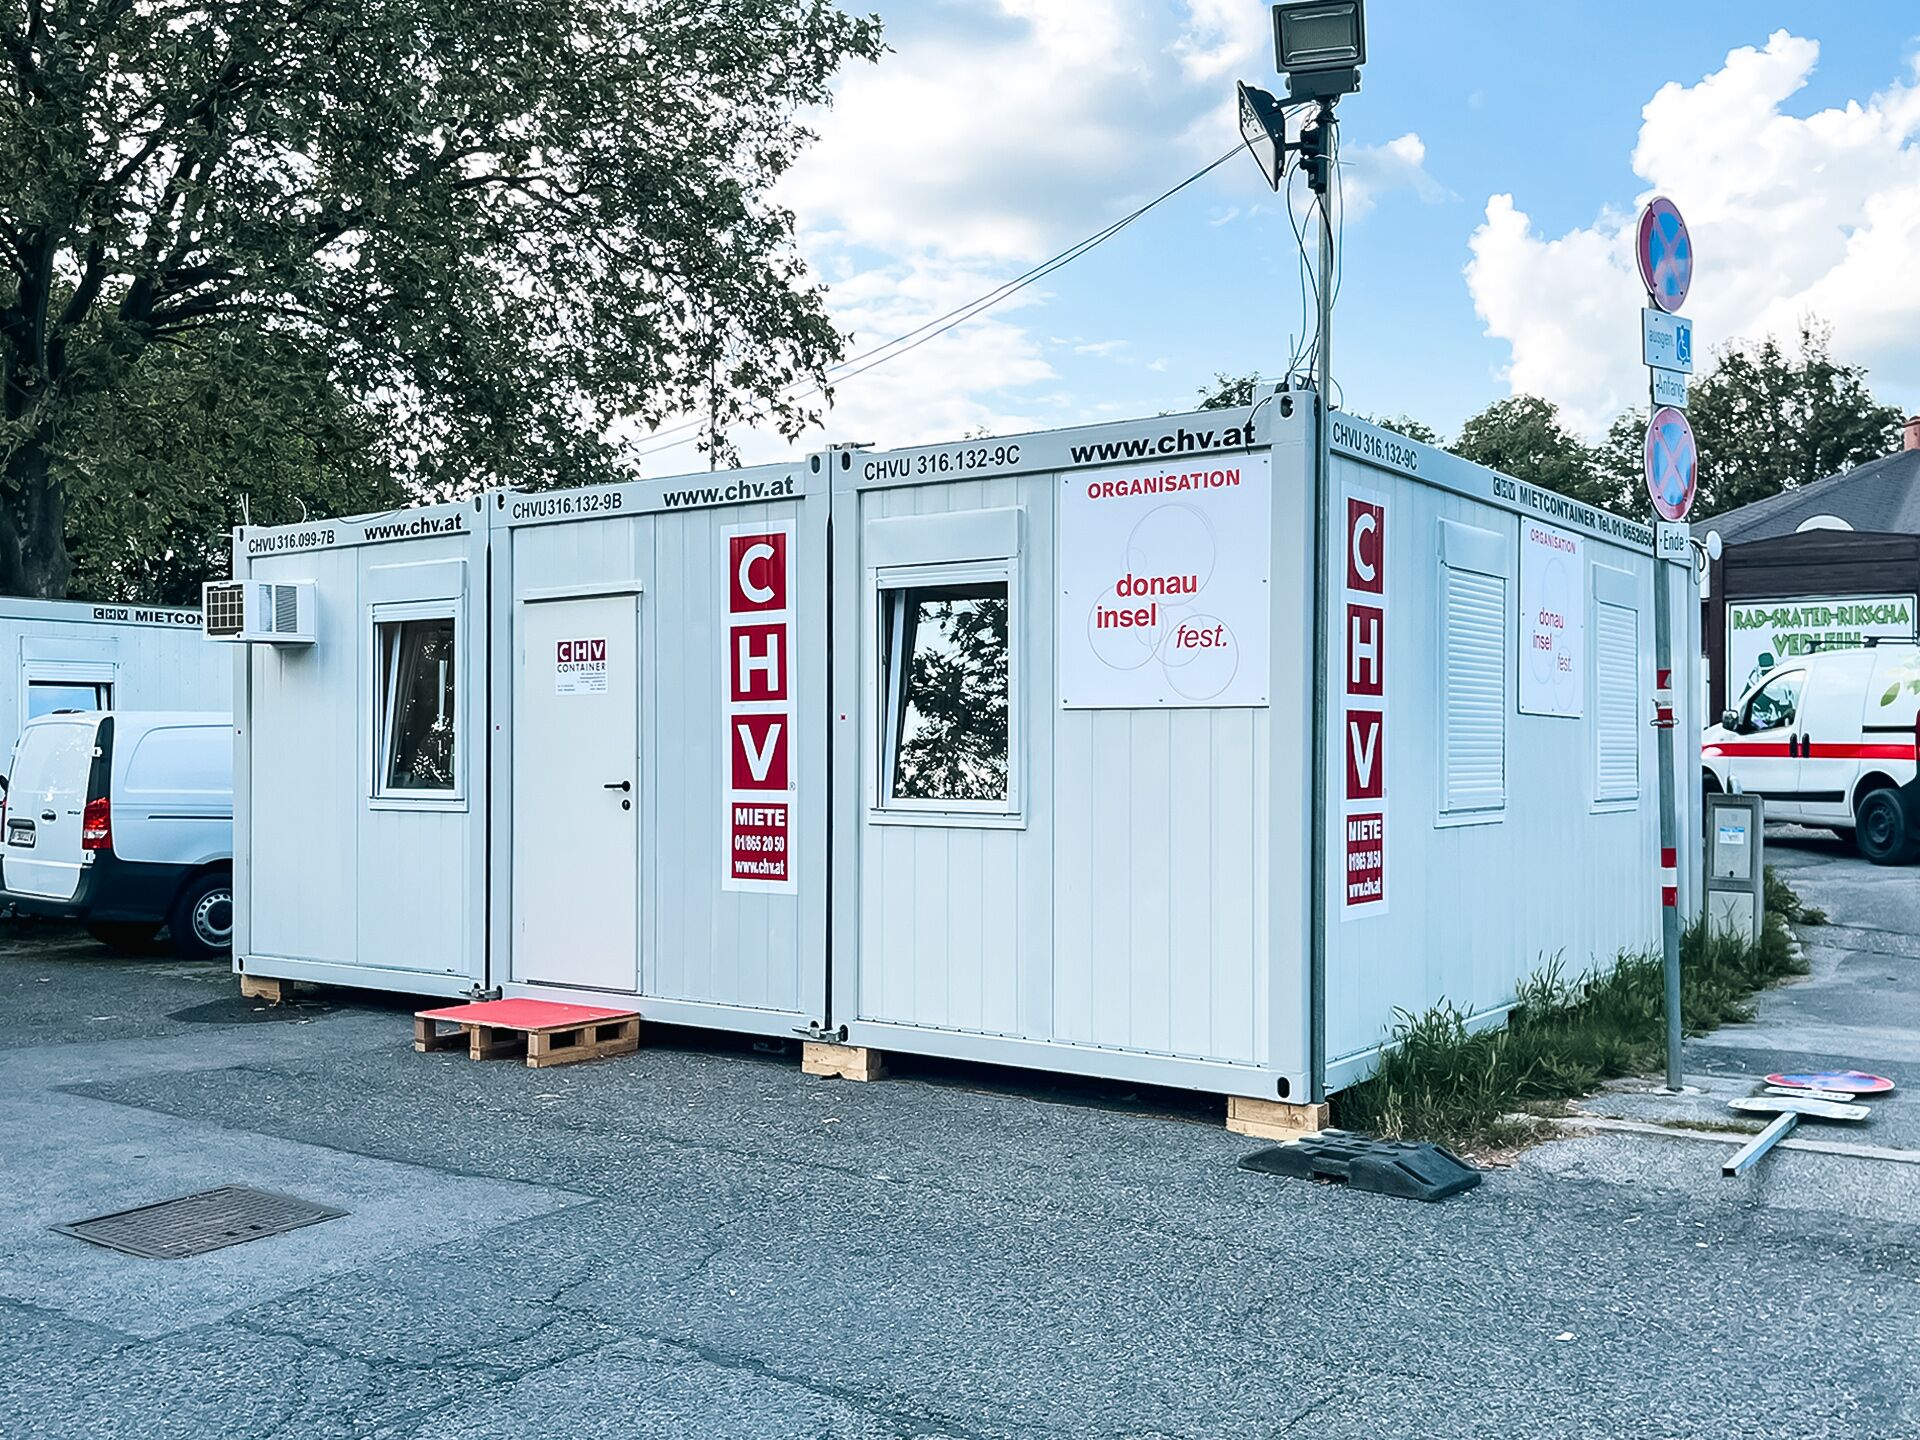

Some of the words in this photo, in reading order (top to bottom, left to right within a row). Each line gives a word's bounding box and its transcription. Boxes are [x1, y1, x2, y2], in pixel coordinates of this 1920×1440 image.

[1658, 374, 1684, 403] Anfang
[1071, 421, 1256, 463] www.chv.at
[1333, 422, 1362, 451] CHVU
[1363, 434, 1418, 471] 316.132-9C
[864, 458, 911, 482] CHVU
[917, 445, 1021, 475] 316.132-9C
[663, 475, 794, 507] www.chv.at
[1087, 469, 1240, 499] ORGANISATION
[1519, 486, 1596, 528] MIETCONTAINER
[364, 513, 462, 541] www.chv.at
[1530, 528, 1576, 554] ORGANISATION
[1663, 529, 1685, 551] Ende
[1116, 573, 1198, 597] donau
[94, 608, 128, 620] CHV
[1096, 602, 1157, 629] insel
[1539, 607, 1564, 628] donau
[1733, 603, 1910, 630] RAD-SKATER-RIKSCHA
[1176, 624, 1228, 649] fest.
[1533, 629, 1553, 651] insel
[557, 640, 606, 662] CHV
[557, 662, 606, 673] CONTAINER
[735, 807, 785, 827] MIETE
[1348, 819, 1381, 842] MIETE
[762, 836, 773, 852] 20
[774, 836, 785, 852] 50
[734, 857, 785, 876] www.chv.at
